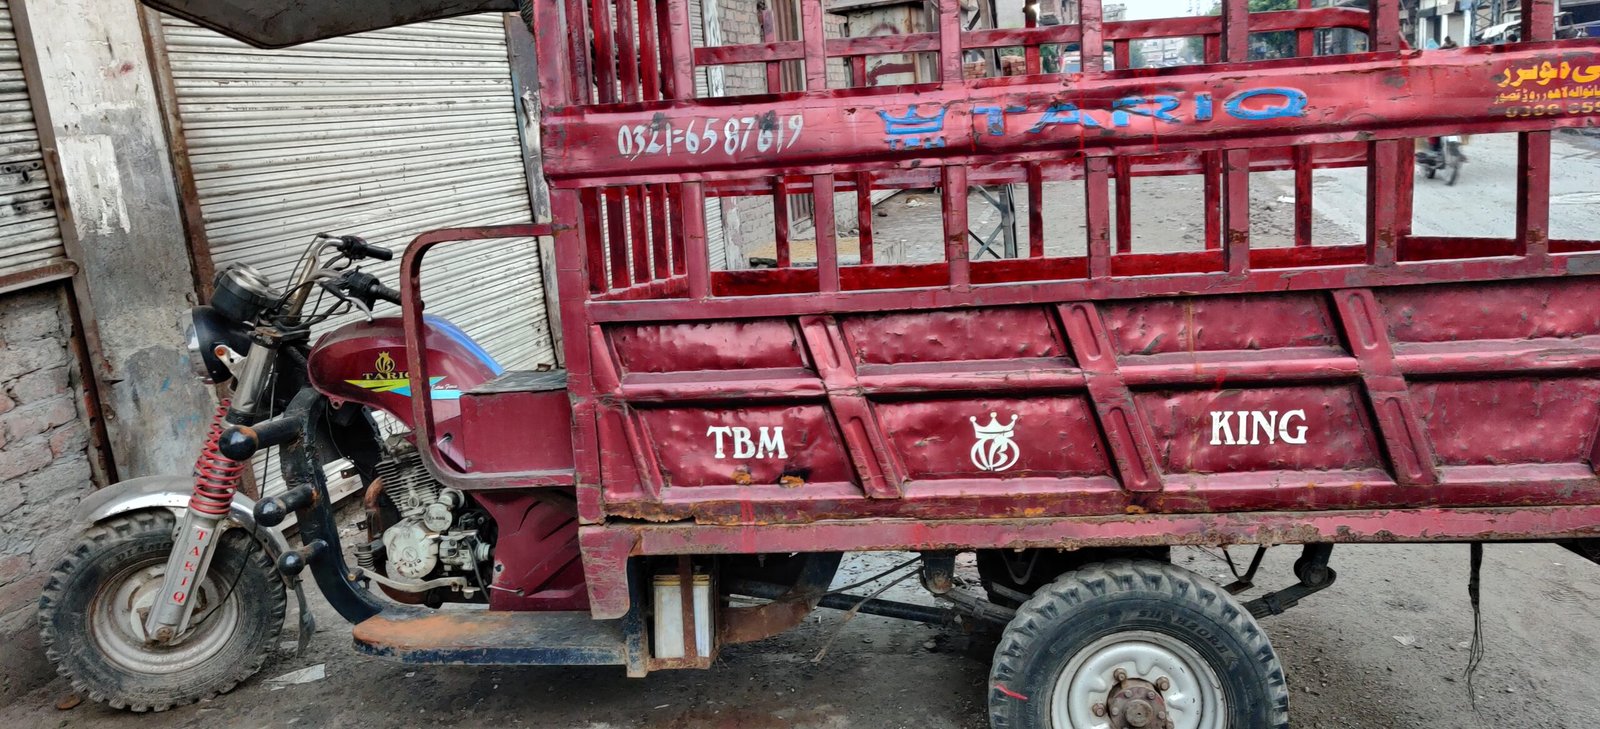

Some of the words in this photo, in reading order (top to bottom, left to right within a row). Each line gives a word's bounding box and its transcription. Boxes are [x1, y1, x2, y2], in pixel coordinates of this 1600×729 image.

[973, 86, 1309, 136] TARIQ
[706, 425, 788, 459] TBM
[1209, 409, 1308, 445] KING
[172, 529, 207, 603] TARIQ
